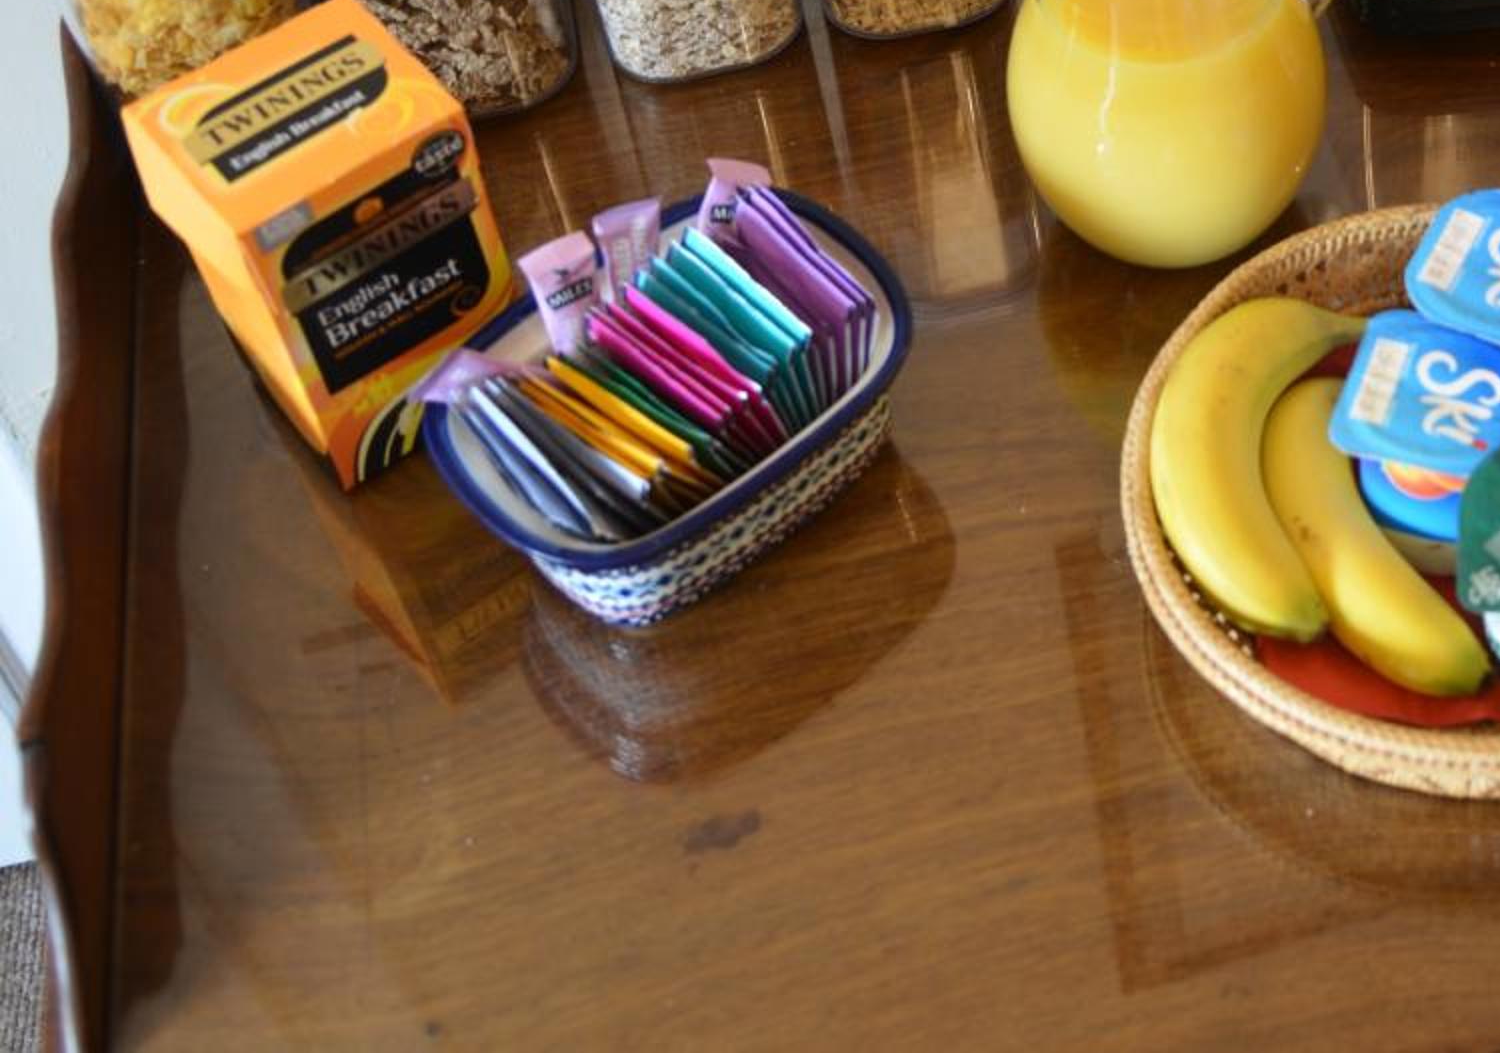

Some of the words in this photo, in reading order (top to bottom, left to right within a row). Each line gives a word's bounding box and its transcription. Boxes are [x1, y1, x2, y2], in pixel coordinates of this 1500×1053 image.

[207, 52, 365, 146] TWININGS
[229, 131, 292, 172] English
[289, 90, 367, 137] Breakfast
[303, 197, 460, 297] TWININGS
[317, 272, 401, 326] English
[324, 258, 463, 348] Breakfast
